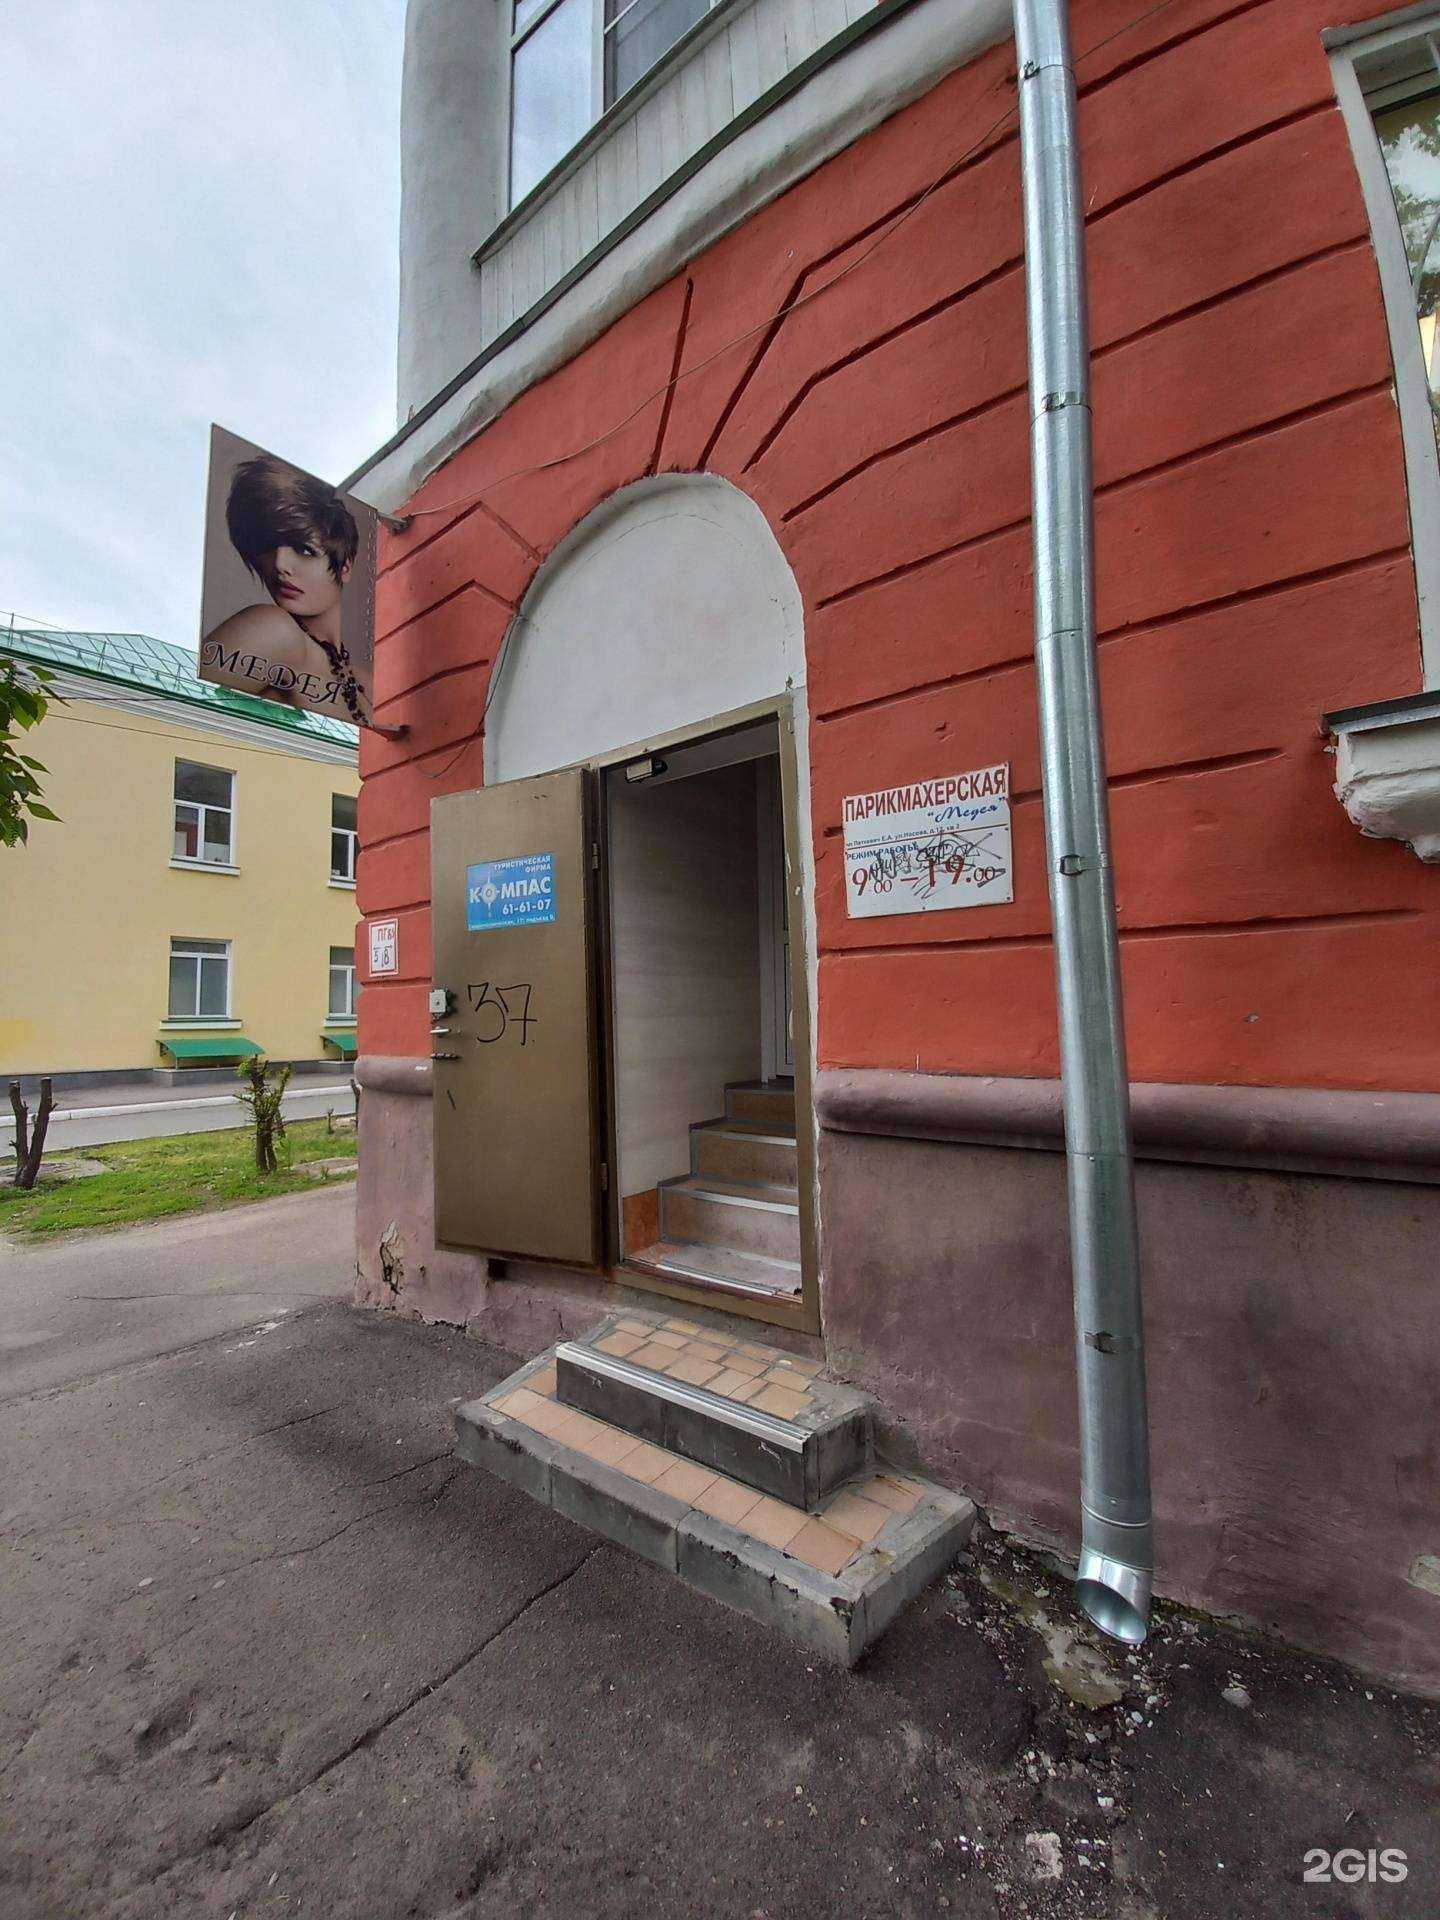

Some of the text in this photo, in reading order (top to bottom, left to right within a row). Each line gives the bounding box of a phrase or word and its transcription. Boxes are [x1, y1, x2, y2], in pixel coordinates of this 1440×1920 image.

[845, 768, 1007, 822] ПАРИКМАХЕРСКАЯ
[846, 848, 877, 861] РЕЖИМ
[502, 898, 551, 915] 61-61-07
[467, 981, 538, 1046] 37
